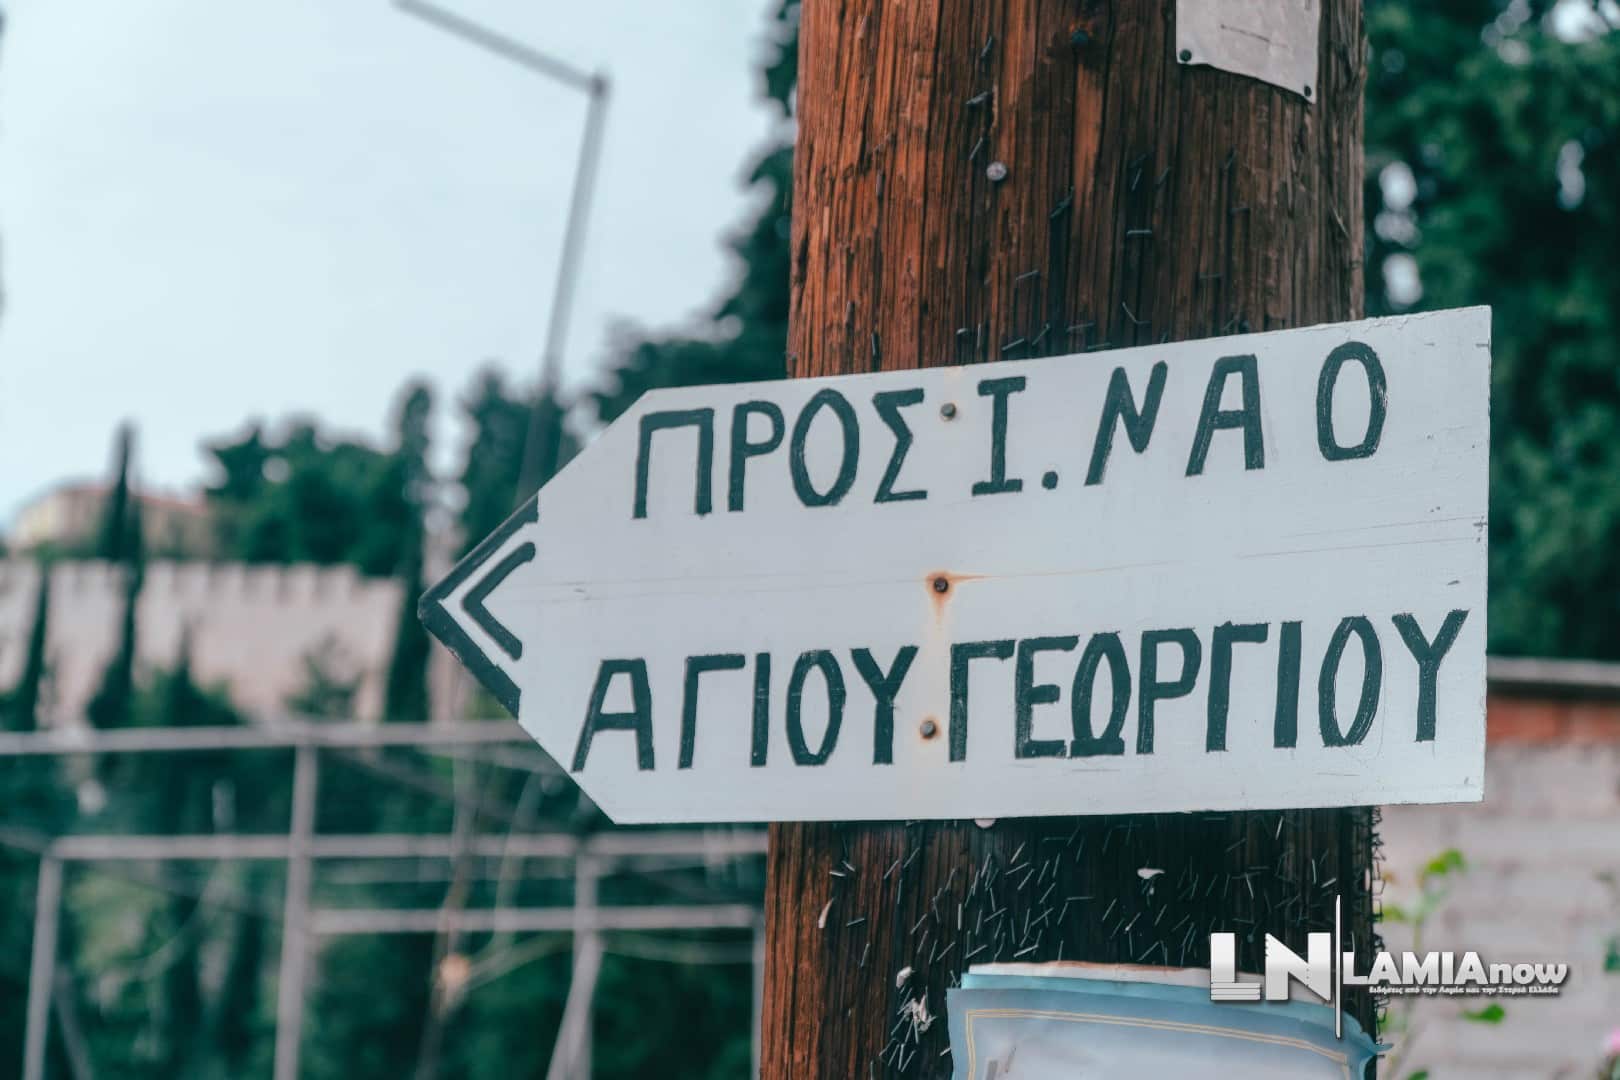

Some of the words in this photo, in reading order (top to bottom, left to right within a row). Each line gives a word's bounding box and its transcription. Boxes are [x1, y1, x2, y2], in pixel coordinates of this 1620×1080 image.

[632, 387, 928, 519] ΠΡΟΣ
[1084, 341, 1387, 487] ΝΑΟ
[570, 645, 919, 773] ΑΓΙΟΥ
[948, 608, 1470, 763] ΓΕΩΡΓΙΟΥ
